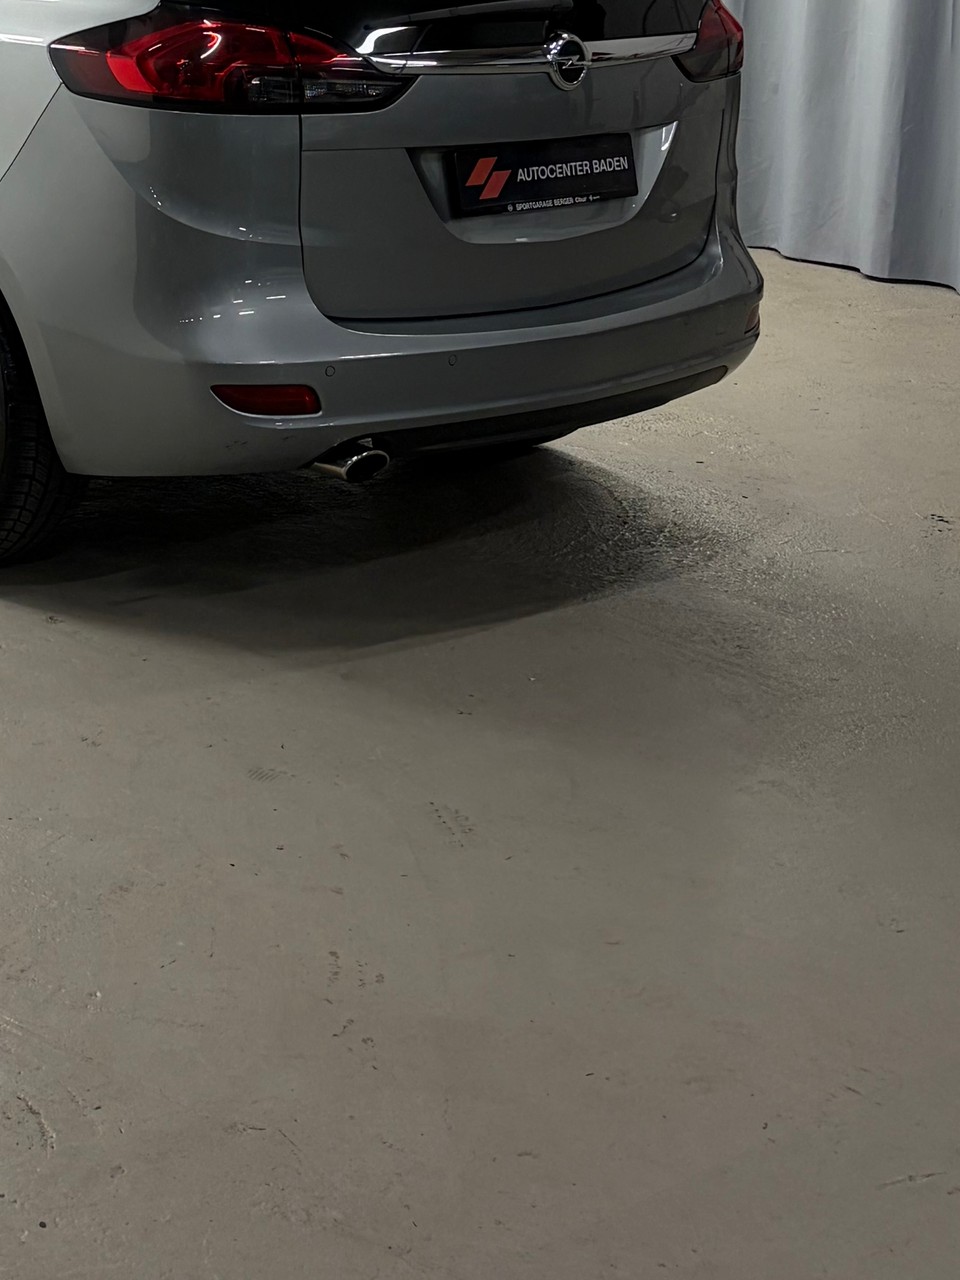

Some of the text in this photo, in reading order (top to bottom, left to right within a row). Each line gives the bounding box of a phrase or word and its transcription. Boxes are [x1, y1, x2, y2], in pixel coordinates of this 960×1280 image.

[517, 156, 628, 182] AUTOCENTER BADEN
[516, 200, 553, 211] SPORTGARAGE
[554, 198, 574, 206] BERGER
